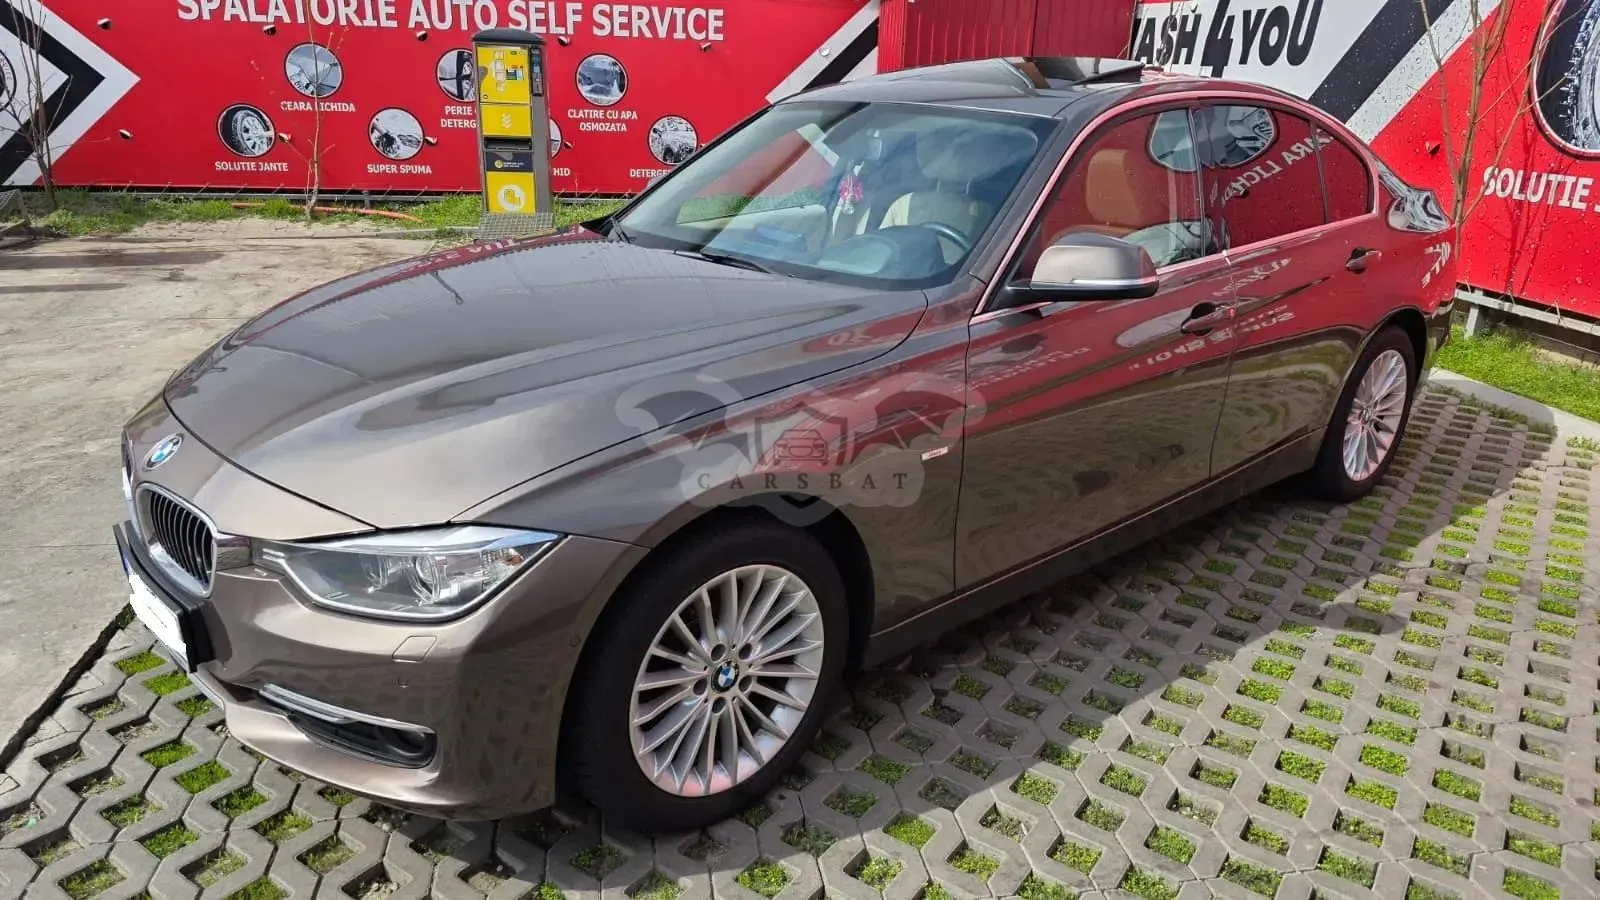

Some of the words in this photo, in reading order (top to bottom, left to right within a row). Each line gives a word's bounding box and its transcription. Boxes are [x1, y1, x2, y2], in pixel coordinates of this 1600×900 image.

[178, 0, 398, 27] SPALATORIE
[408, 0, 498, 30] AUTO
[508, 3, 582, 35] SELF
[592, 5, 724, 41] SERVICE
[1130, 14, 1203, 66] ASH
[1200, 0, 1235, 78] 4
[1239, 0, 1323, 66] YOU
[280, 101, 312, 112] CEARA
[445, 106, 472, 116] PERIE
[567, 109, 604, 119] CLATIRE
[606, 110, 618, 119] CU
[620, 111, 638, 120] APA
[441, 119, 478, 128] DETERG
[579, 122, 627, 132] OSMOZATA
[215, 161, 257, 171] SOLUTIE
[259, 162, 289, 172] JANTE
[367, 164, 398, 174] SUPER
[400, 165, 432, 174] SPUMA
[553, 168, 571, 176] HID
[630, 168, 671, 178] DETERGE
[1483, 166, 1593, 210] SOLUTIE
